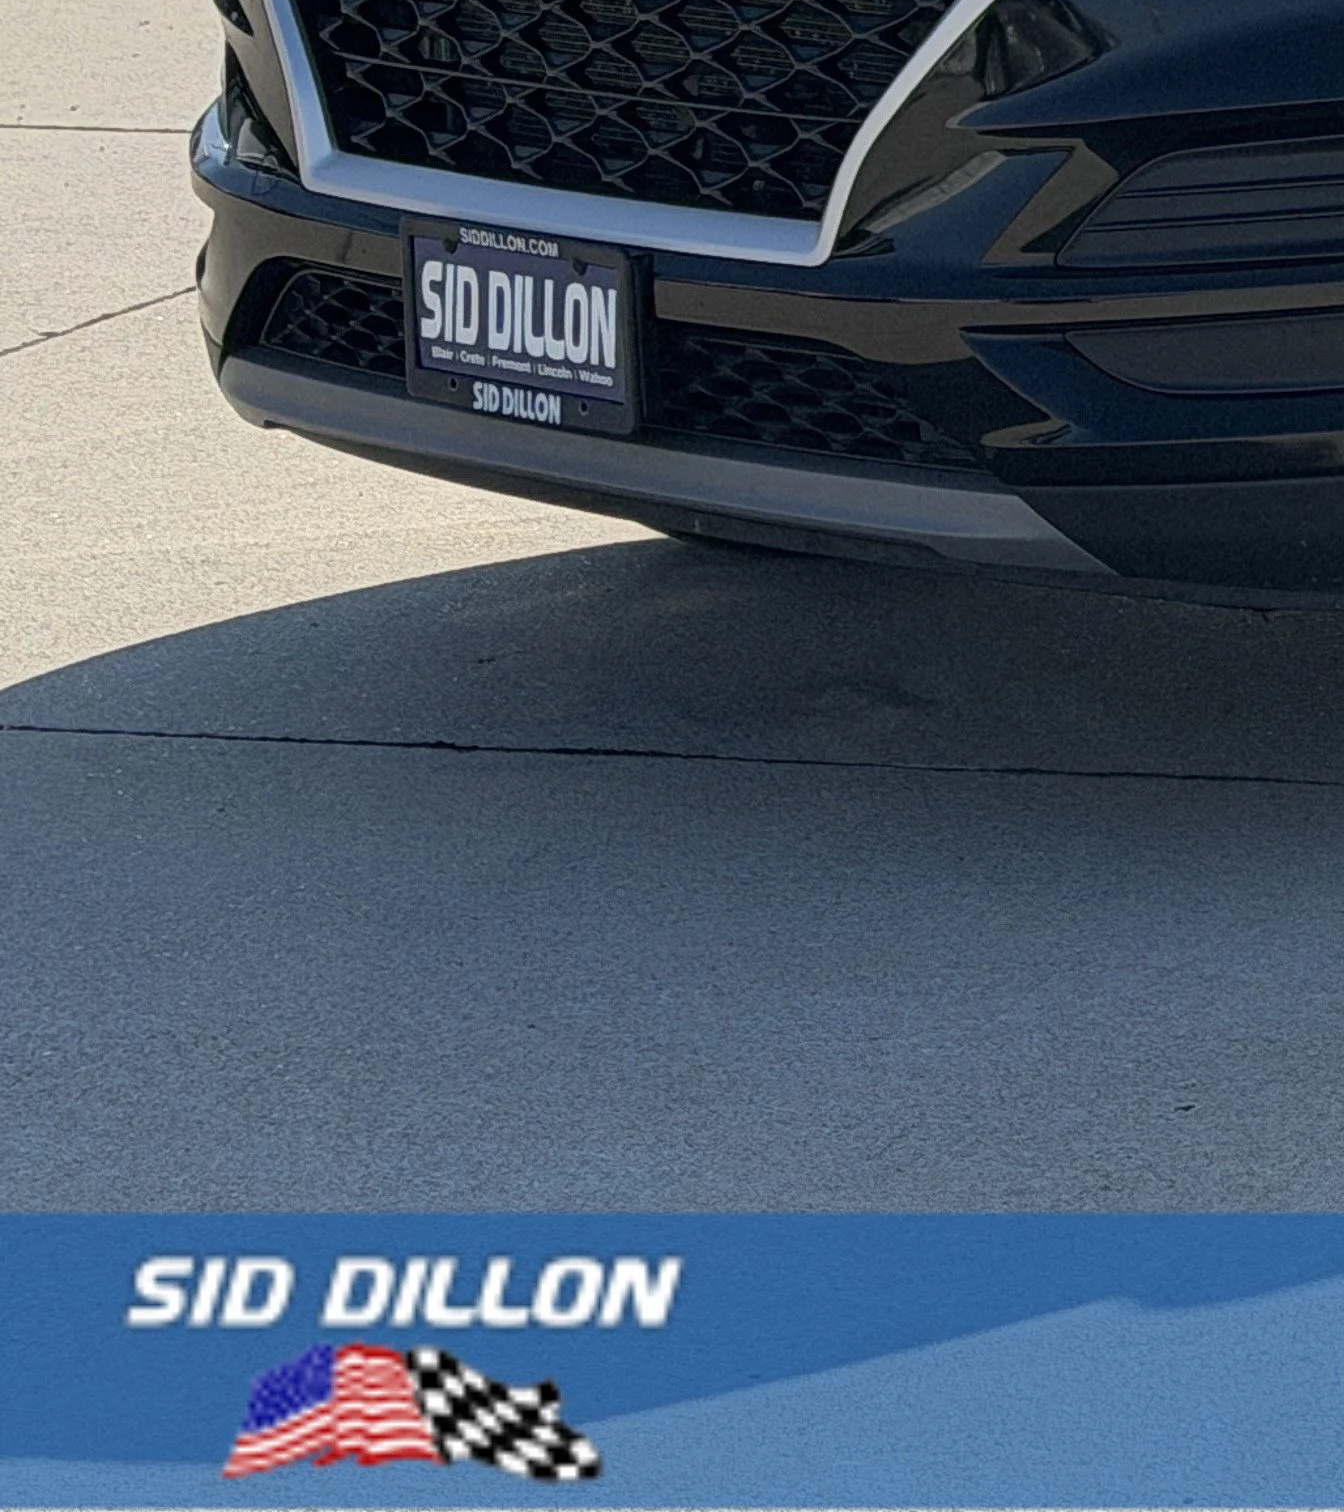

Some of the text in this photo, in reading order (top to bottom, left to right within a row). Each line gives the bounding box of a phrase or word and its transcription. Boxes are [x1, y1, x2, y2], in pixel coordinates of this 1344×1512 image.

[459, 227, 560, 258] SIDDILLON.COM
[420, 260, 617, 369] SID DILLON
[537, 363, 573, 380] Lincoln
[472, 380, 562, 426] SID DILLON
